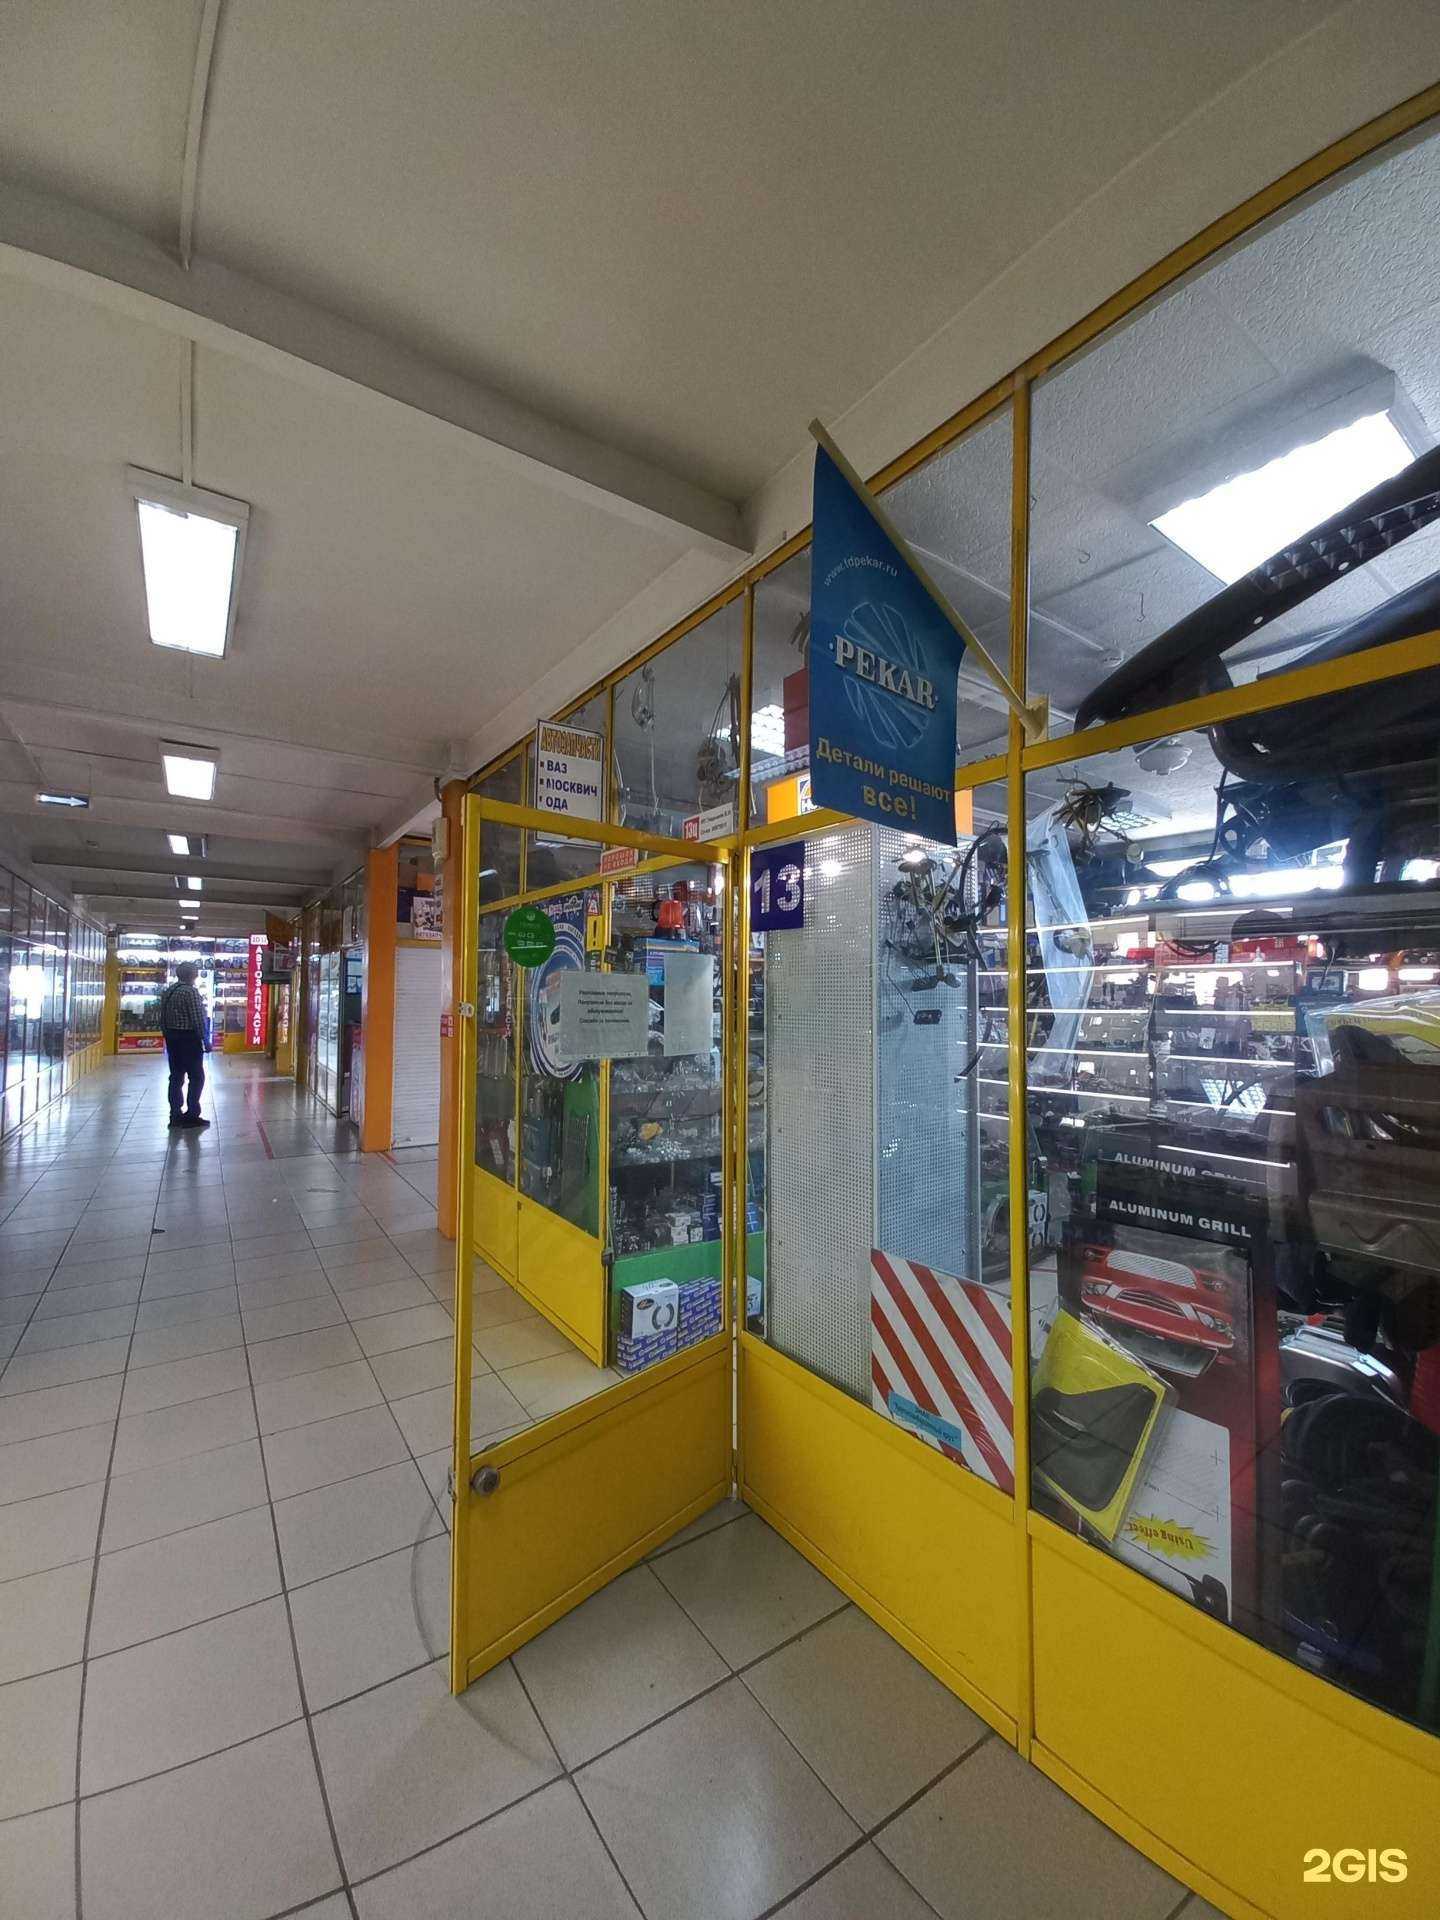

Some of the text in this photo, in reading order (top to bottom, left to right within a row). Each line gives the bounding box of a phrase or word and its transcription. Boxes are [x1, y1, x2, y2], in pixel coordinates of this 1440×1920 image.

[834, 634, 937, 710] PEKAR
[546, 760, 568, 774] ВАЗ
[816, 737, 951, 803] Детали решают
[545, 796, 568, 811] ОДА
[546, 778, 598, 796] МОСКВИЧ
[863, 785, 917, 821] все!
[754, 863, 801, 914] 13
[252, 945, 263, 1045] АВТОЗАПЧАСТИ
[1114, 1152, 1196, 1177] ALUMINUM
[1109, 1200, 1252, 1239] ALUMINUM GRILL
